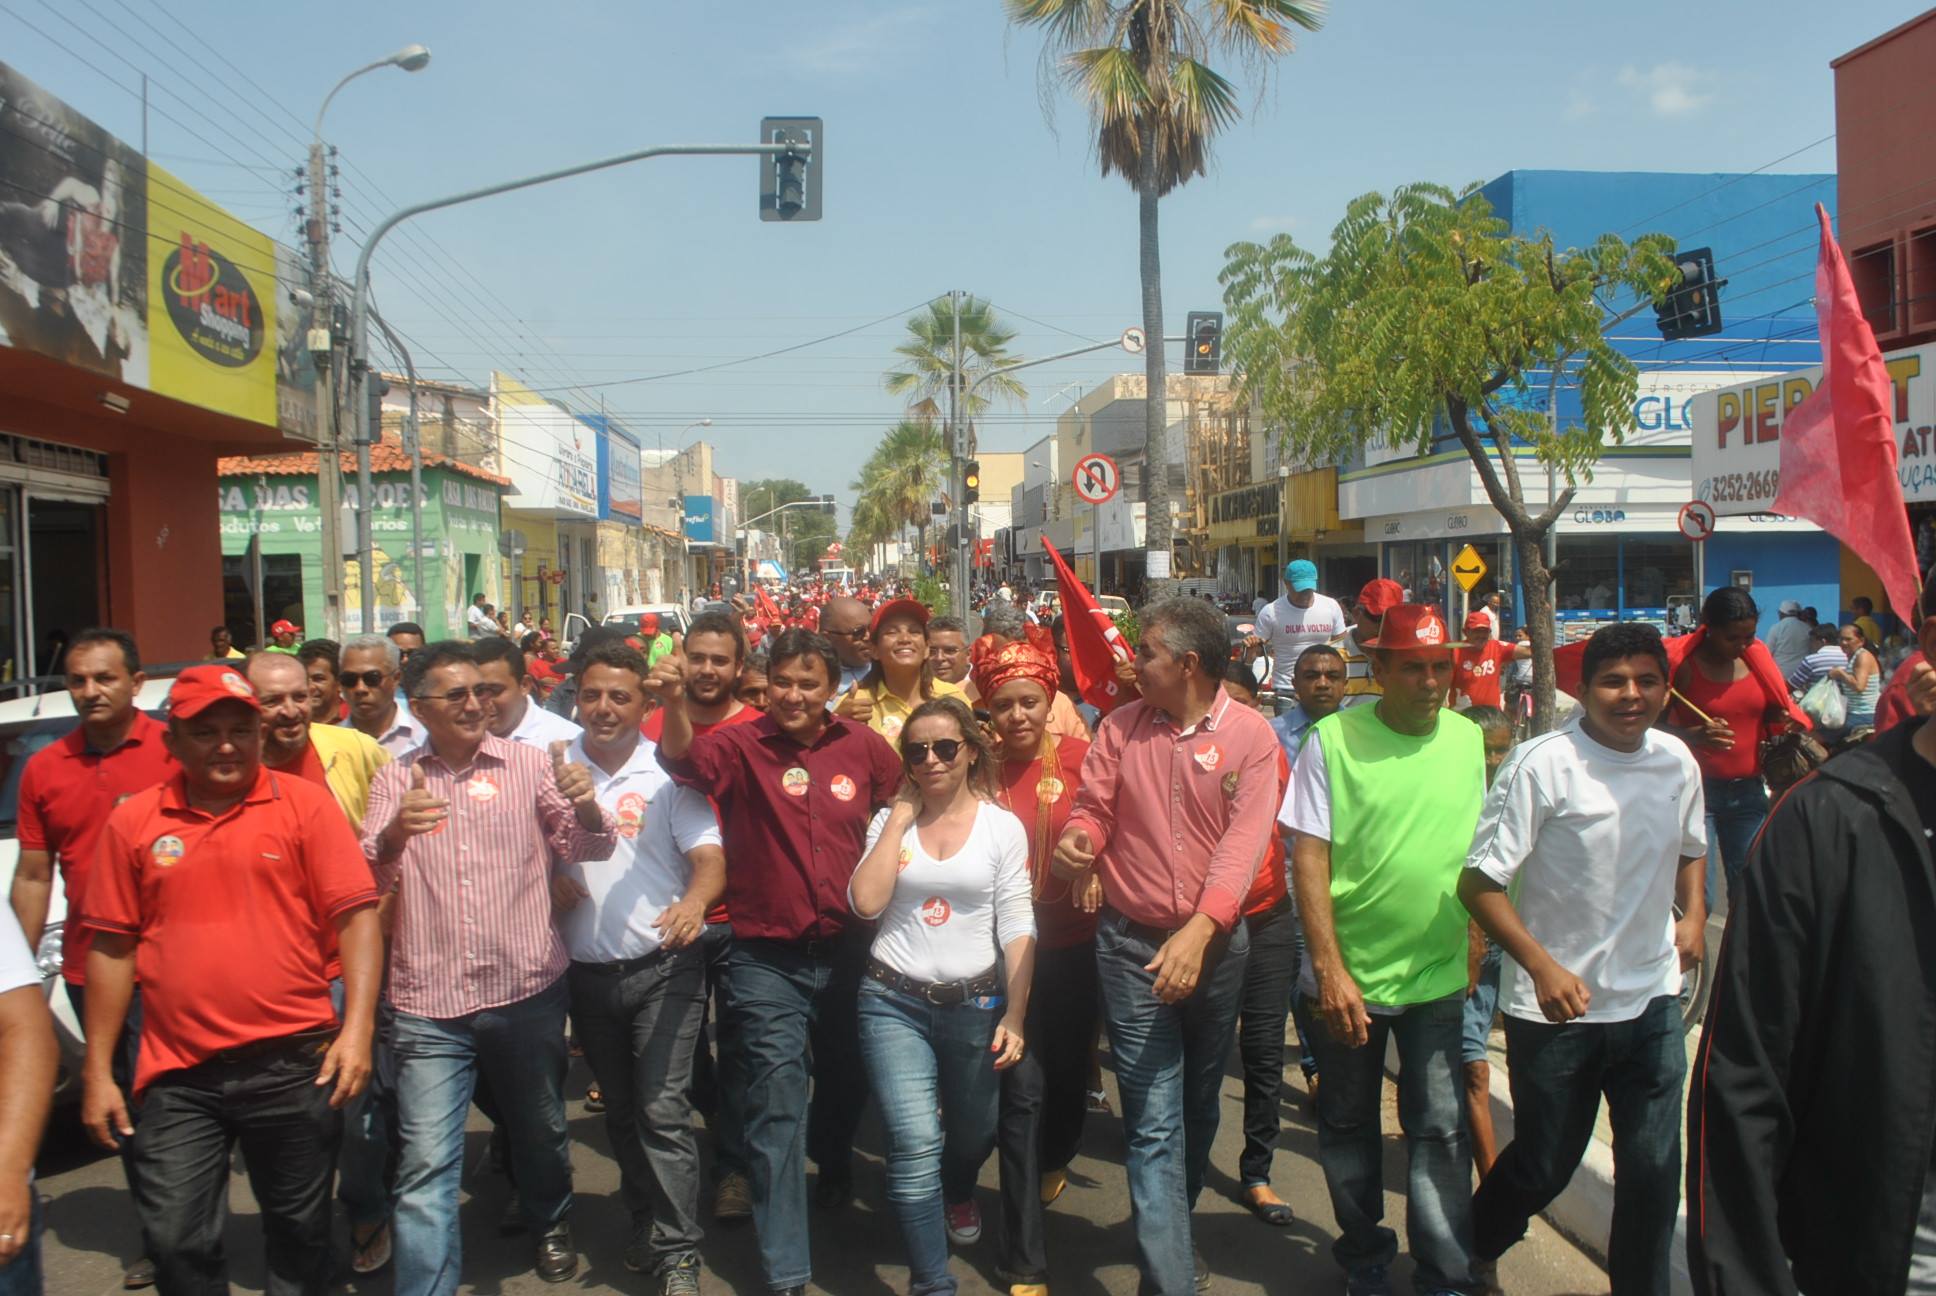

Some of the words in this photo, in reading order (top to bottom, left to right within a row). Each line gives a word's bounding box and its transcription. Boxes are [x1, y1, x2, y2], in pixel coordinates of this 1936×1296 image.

[1902, 425, 1936, 459] AT
[1574, 509, 1626, 525] GLOBO
[1481, 658, 1496, 677] 13
